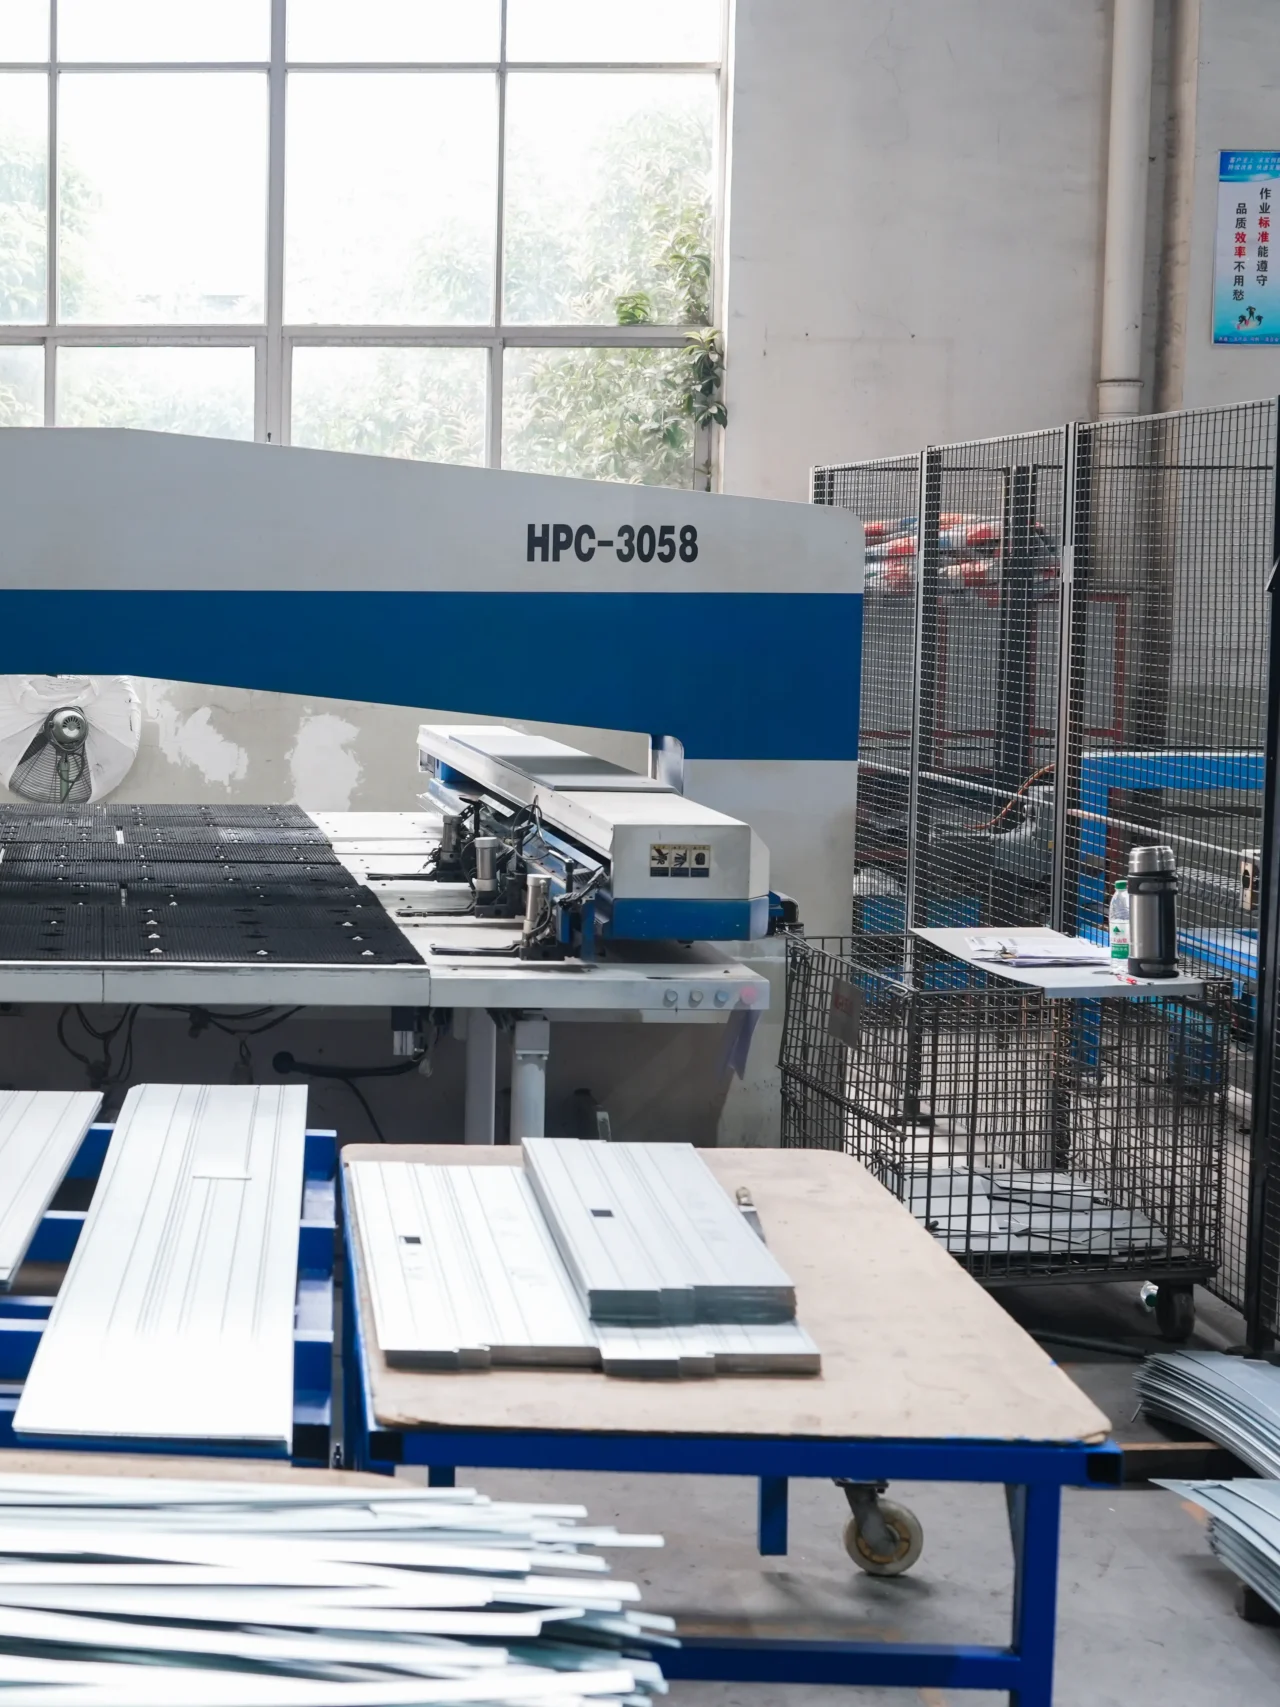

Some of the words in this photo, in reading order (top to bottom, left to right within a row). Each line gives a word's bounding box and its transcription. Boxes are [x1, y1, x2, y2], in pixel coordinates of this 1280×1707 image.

[1232, 202, 1247, 301] 品质效率不用愁
[1256, 187, 1271, 286] 作业标准能遵守
[527, 524, 698, 563] HPC-3058
